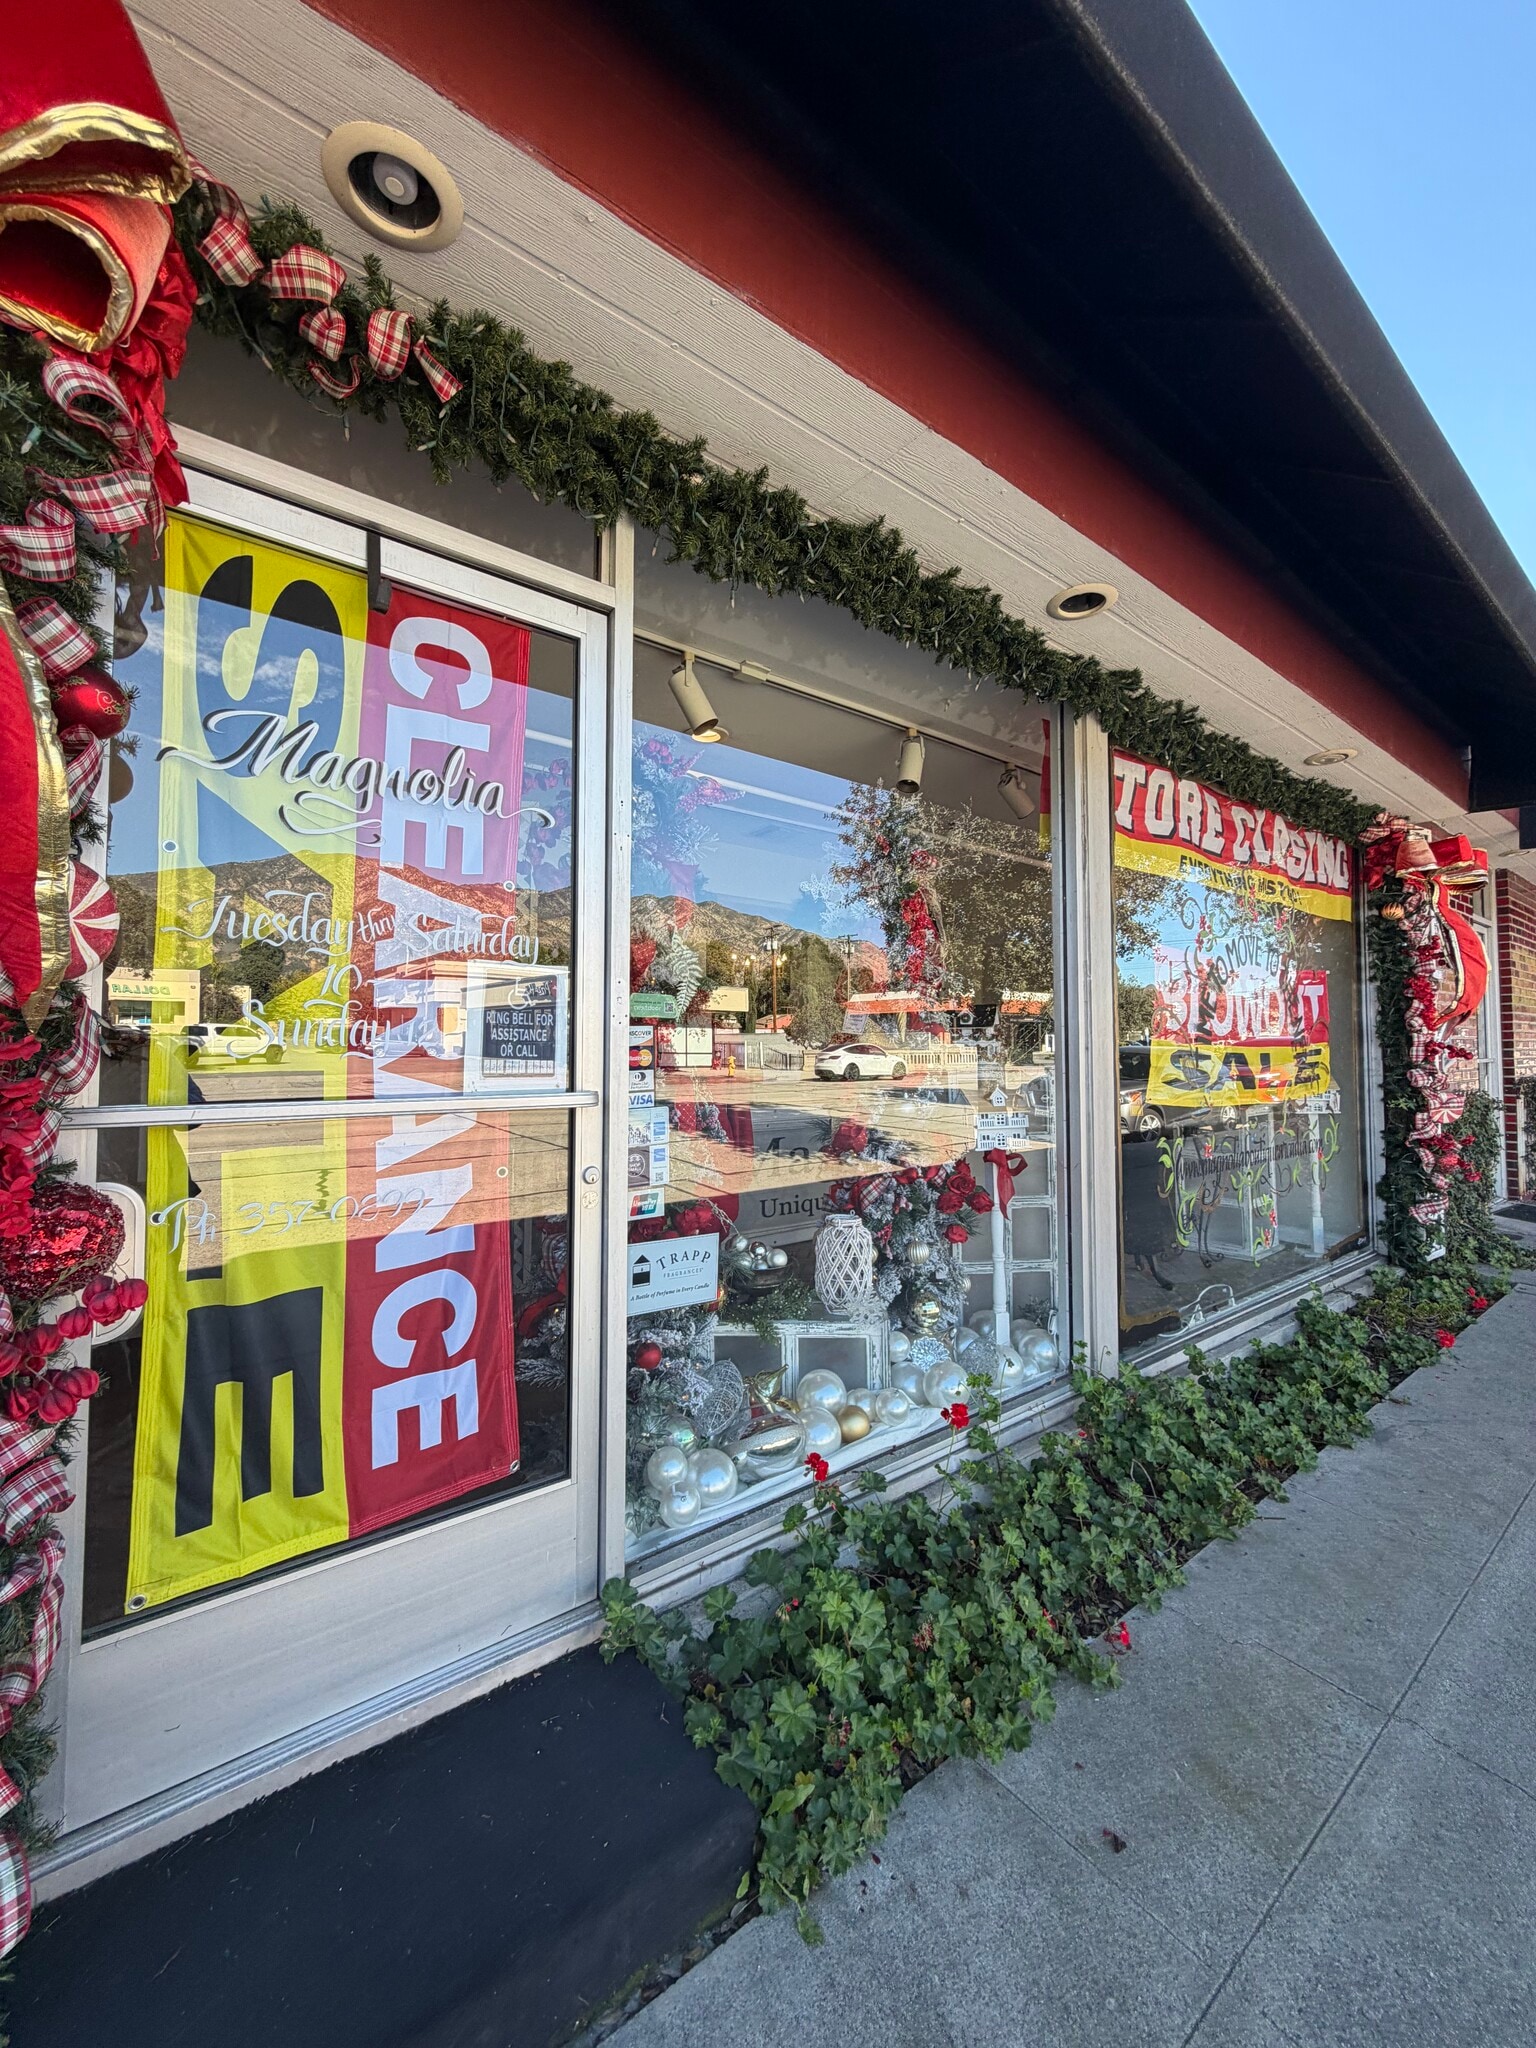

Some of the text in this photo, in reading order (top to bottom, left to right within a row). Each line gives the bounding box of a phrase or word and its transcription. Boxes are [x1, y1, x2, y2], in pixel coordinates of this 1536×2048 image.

[157, 708, 555, 846] Magnolia
[1113, 755, 1226, 856] TORE
[160, 890, 354, 956] Tuesday
[402, 912, 539, 966] Saturday
[1225, 934, 1264, 971] MOVE
[227, 998, 392, 1061] Sunday
[486, 1010, 554, 1026] RING BELL FOR
[491, 1028, 547, 1042] ASSISTANCE
[175, 555, 346, 1538] SALE
[372, 616, 493, 1470] CLEARANCE
[500, 1044, 538, 1057] OR CALL
[1163, 1047, 1324, 1091] SALE
[629, 1094, 654, 1106] VISA
[656, 1249, 711, 1270] TRAPP
[663, 1268, 703, 1278] FRAGRANCES
[656, 1289, 675, 1297] Perfume
[681, 1285, 694, 1293] Every
[694, 1282, 710, 1290] Candle
